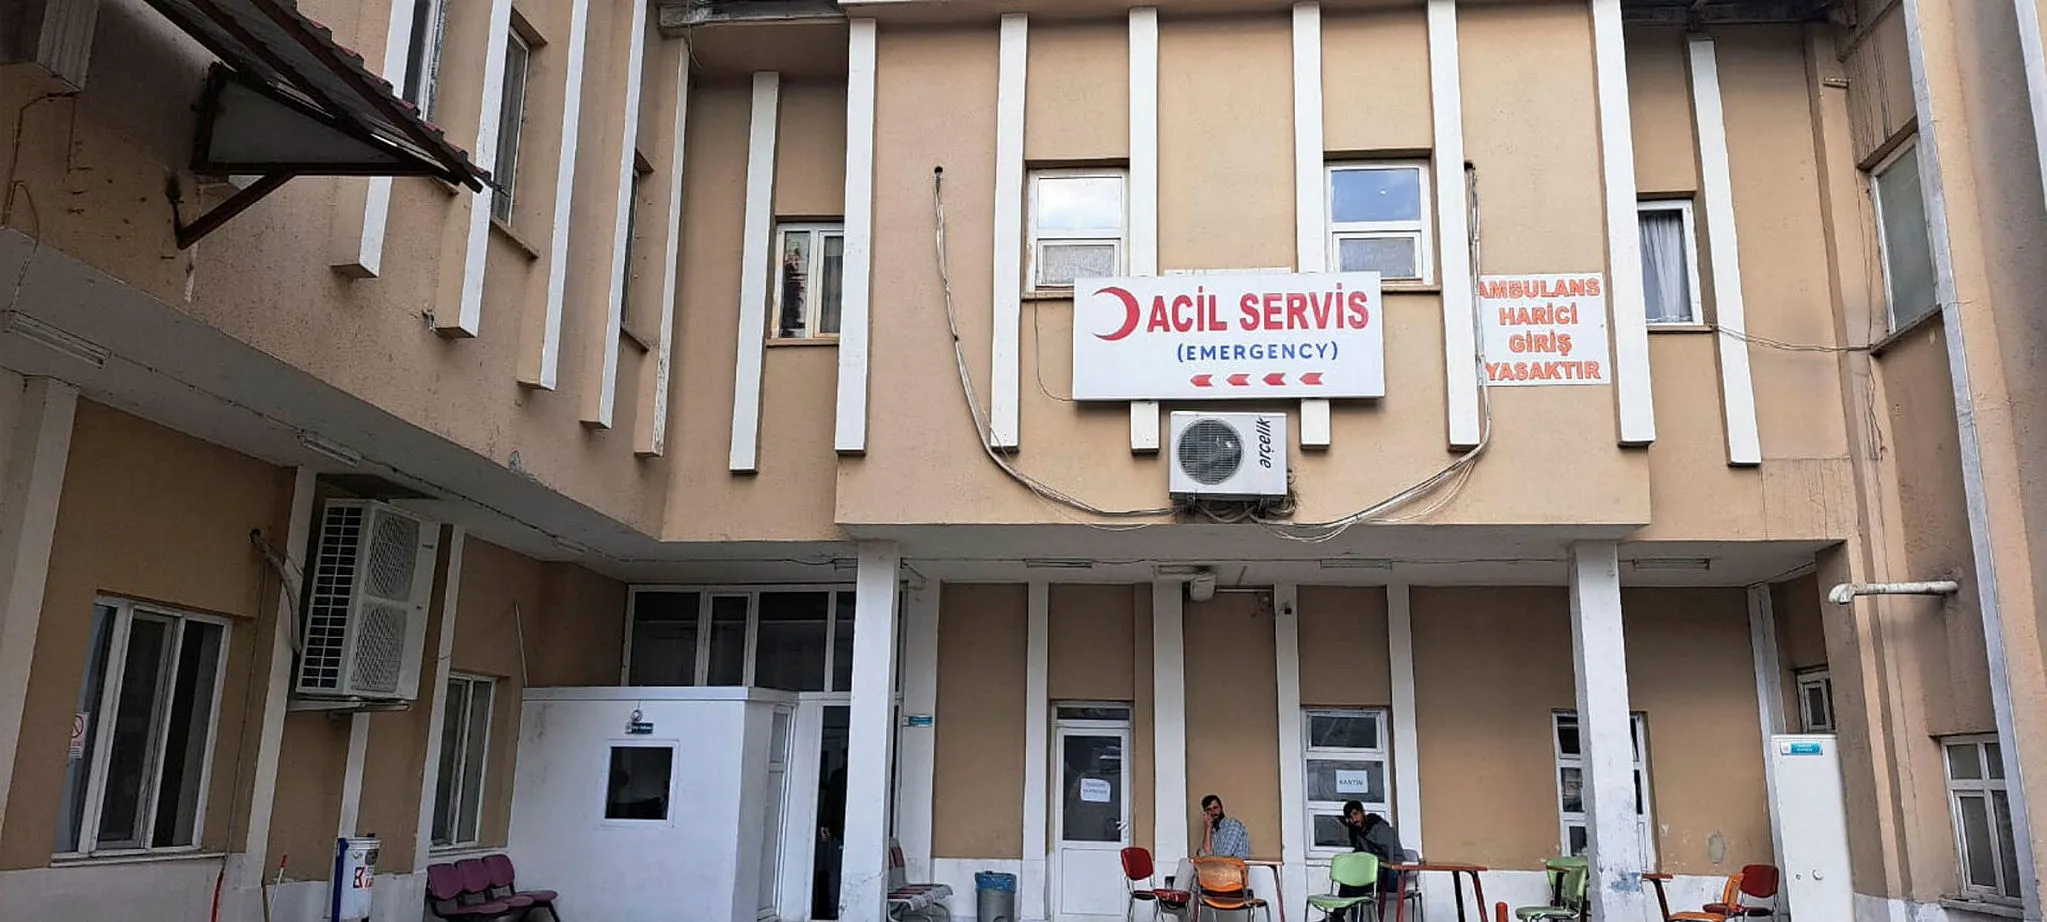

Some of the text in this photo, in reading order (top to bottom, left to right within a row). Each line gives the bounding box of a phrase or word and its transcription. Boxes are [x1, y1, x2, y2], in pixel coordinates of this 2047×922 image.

[1479, 278, 1600, 299] AMBULANS
[1147, 282, 1369, 332] ACİL SERVİS
[1499, 302, 1578, 326] HARİCİ
[1177, 341, 1338, 363] (EMERGENCY)
[1509, 329, 1572, 357] GİRİŞ
[1485, 361, 1601, 381] YASAKTIR
[1256, 415, 1275, 469] arçelik
